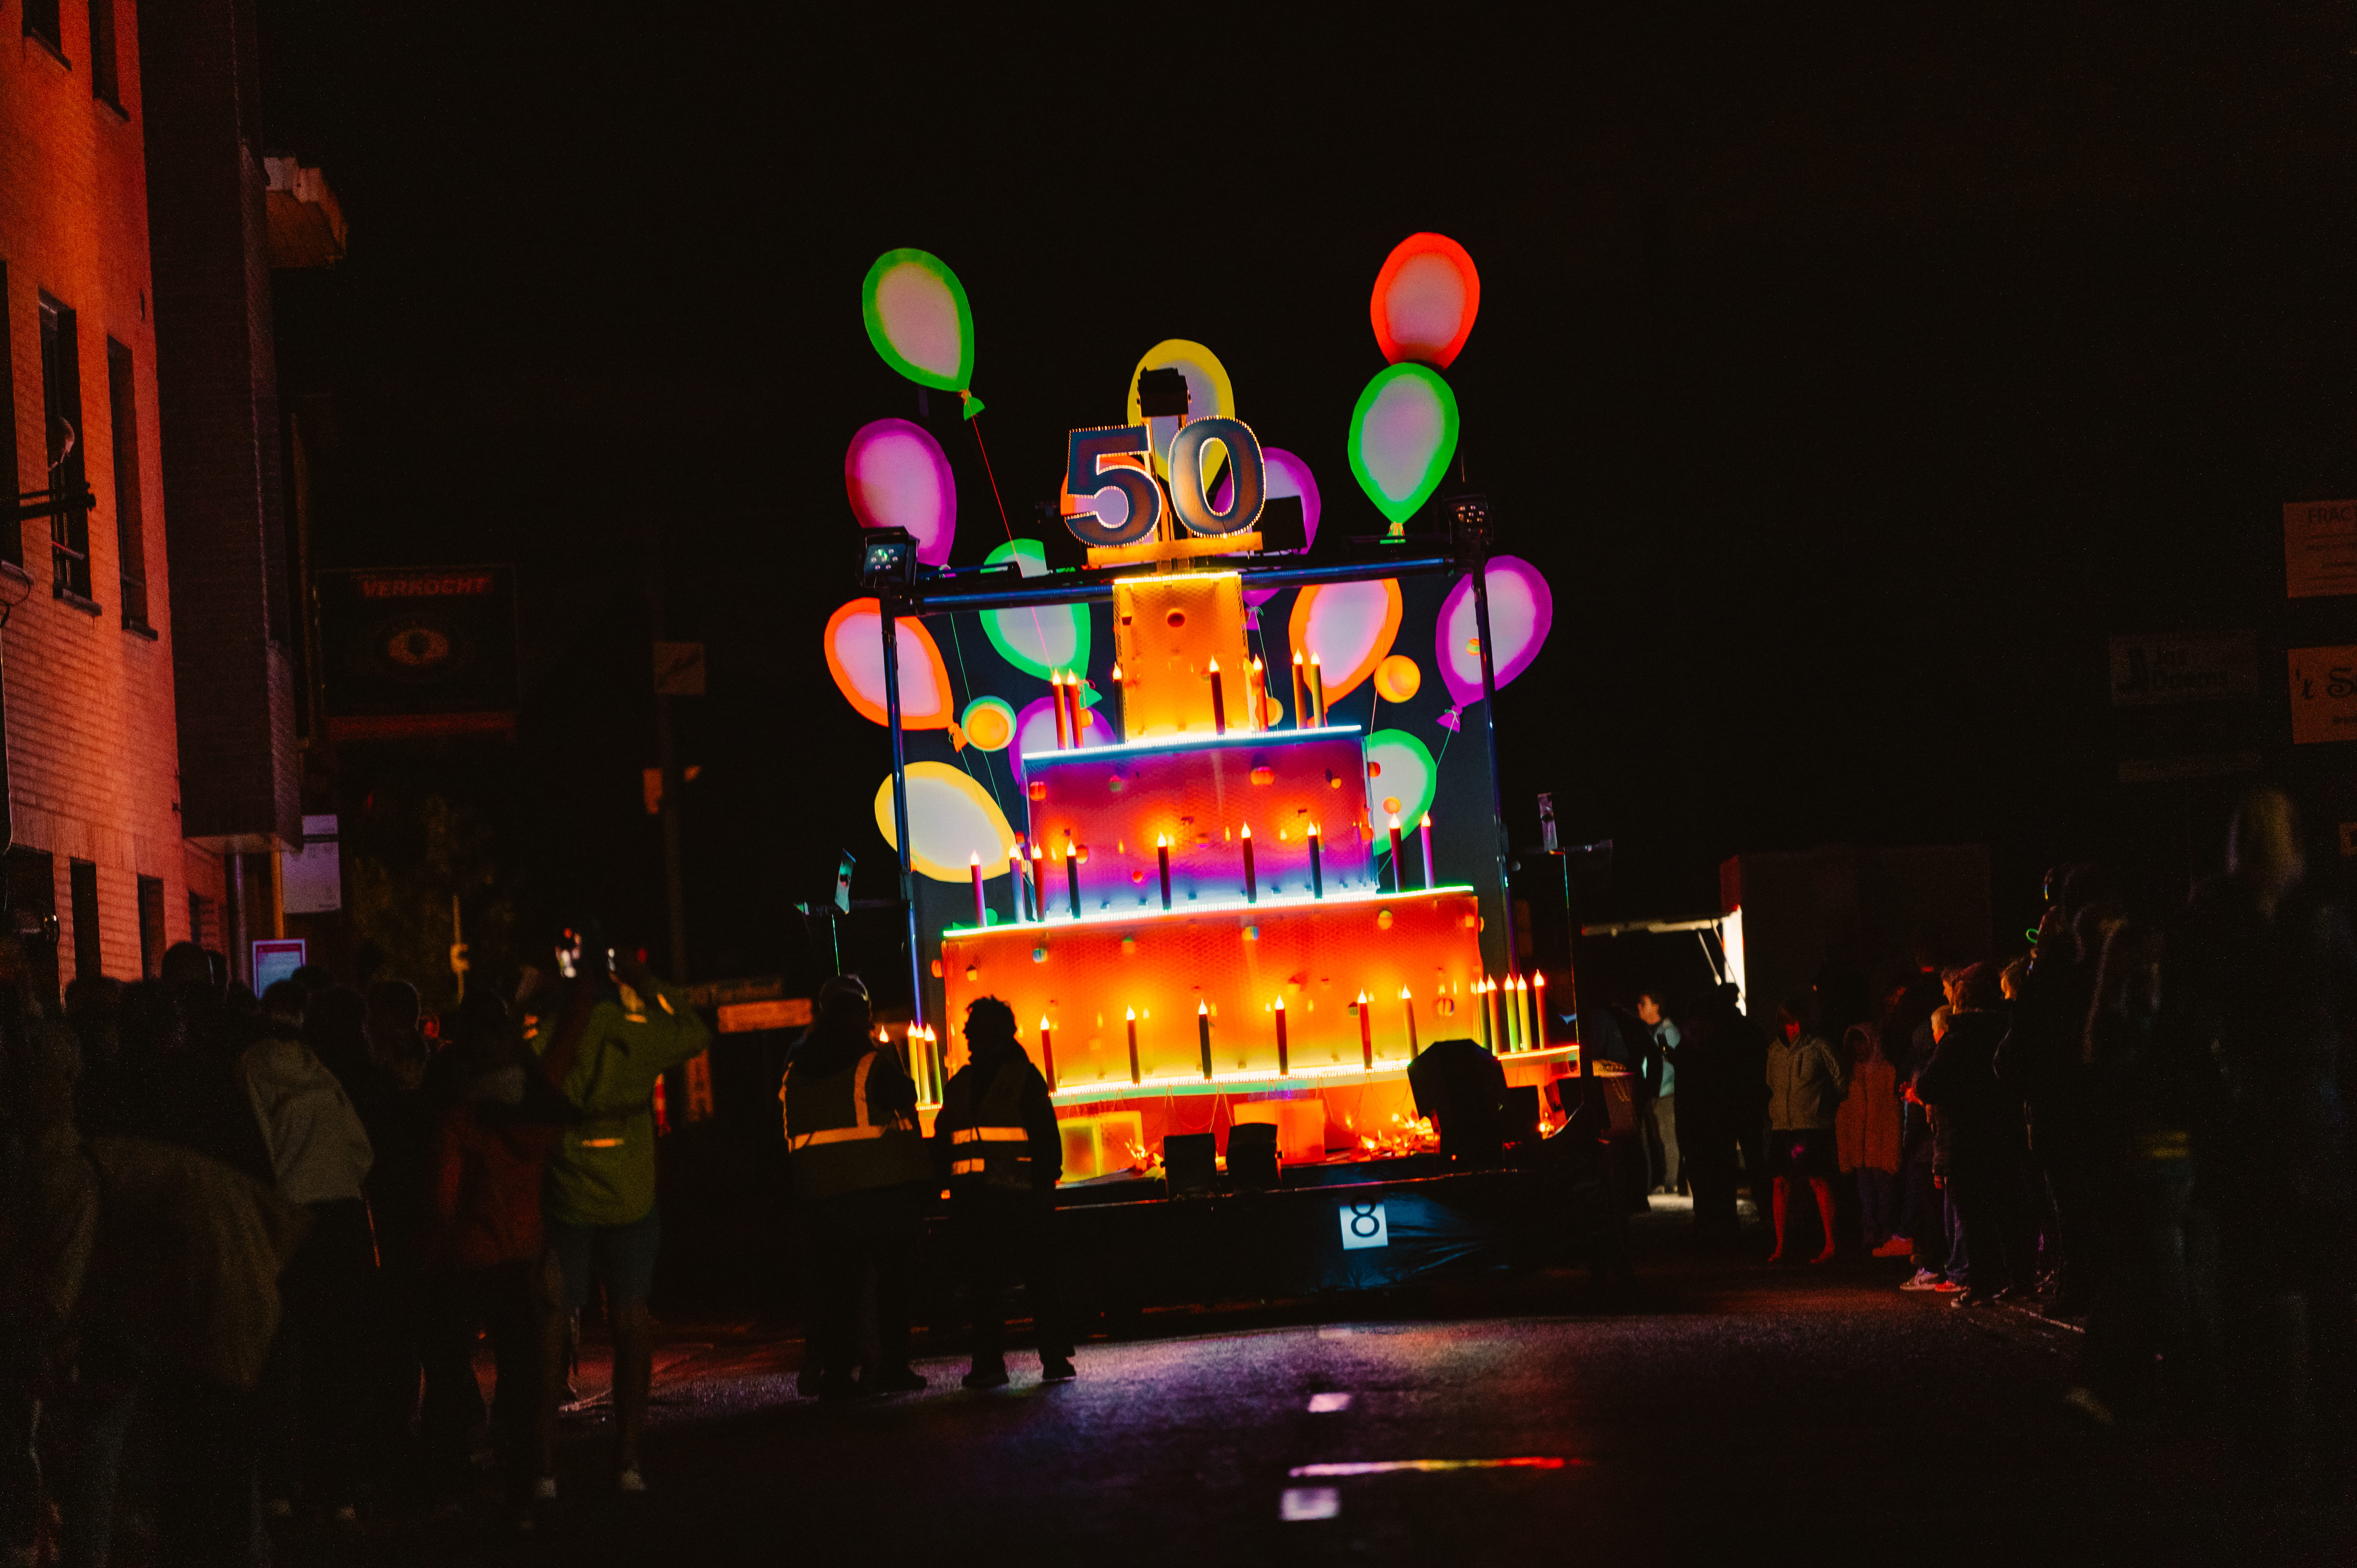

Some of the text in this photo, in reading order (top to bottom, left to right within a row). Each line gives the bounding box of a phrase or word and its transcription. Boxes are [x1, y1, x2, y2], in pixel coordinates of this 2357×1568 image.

[1064, 415, 1266, 548] 50
[362, 577, 491, 597] VERKOCHT
[2327, 667, 2357, 699] S
[1350, 1194, 1380, 1238] 8
